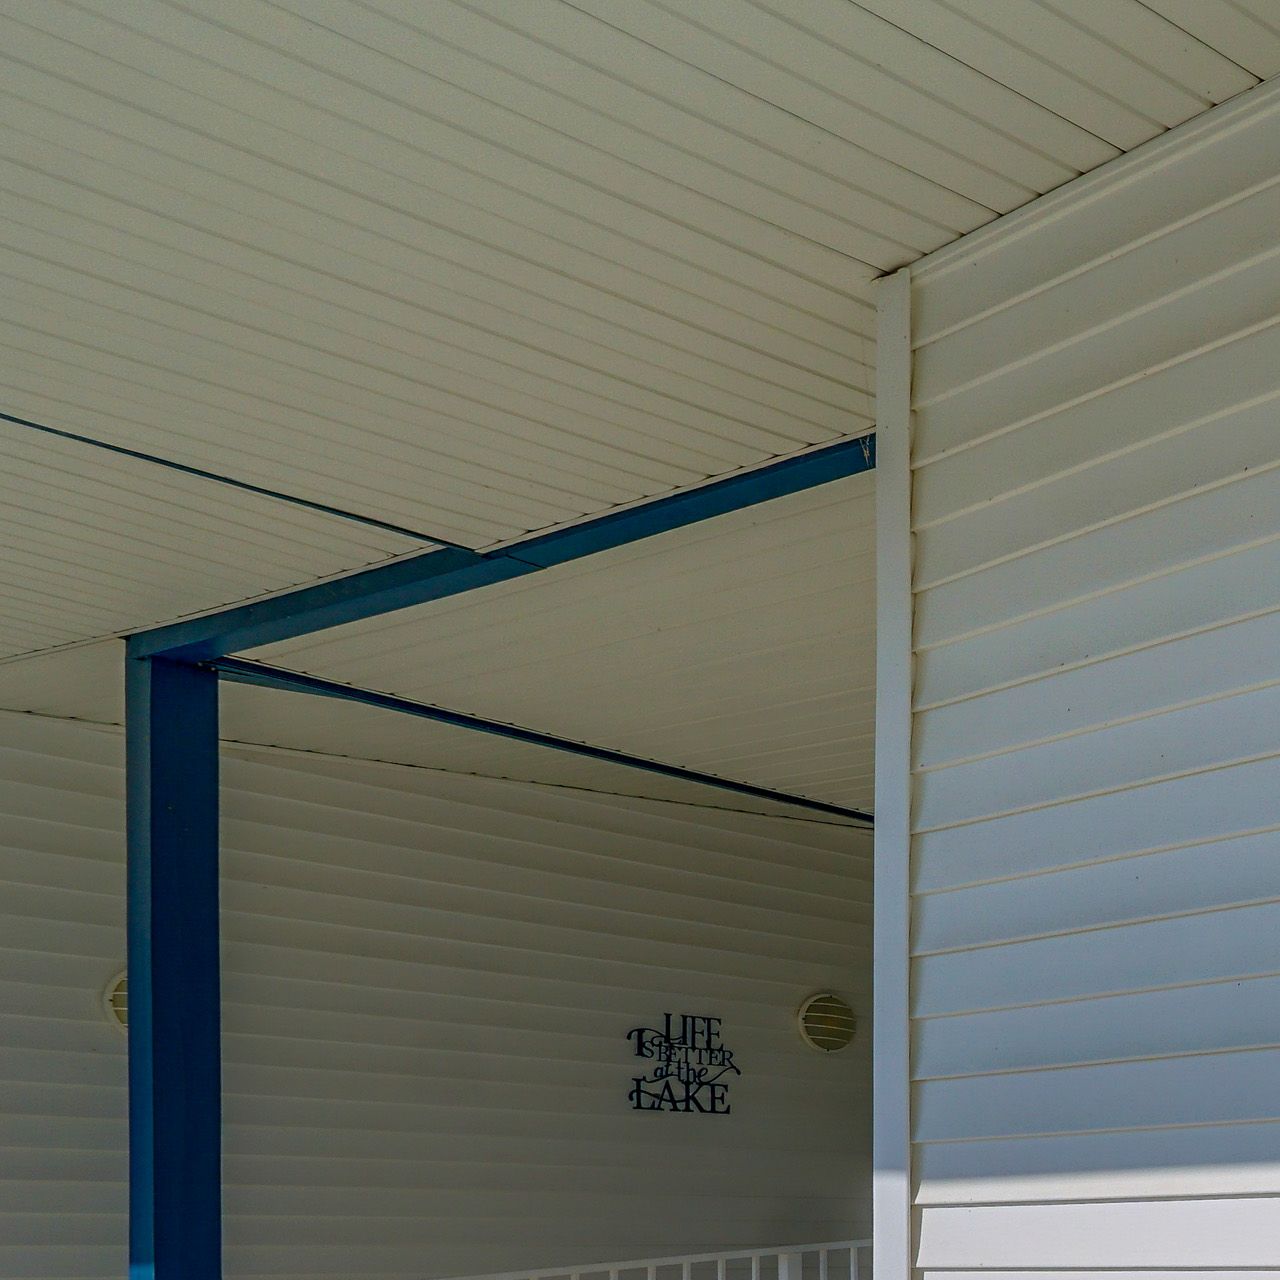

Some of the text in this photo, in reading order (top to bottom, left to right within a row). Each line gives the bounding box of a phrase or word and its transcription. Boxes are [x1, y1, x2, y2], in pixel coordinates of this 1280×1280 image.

[660, 1013, 723, 1051] LIFE
[654, 1058, 709, 1084] at the
[657, 1044, 738, 1070] BETTER
[628, 1076, 731, 1115] LAKE
